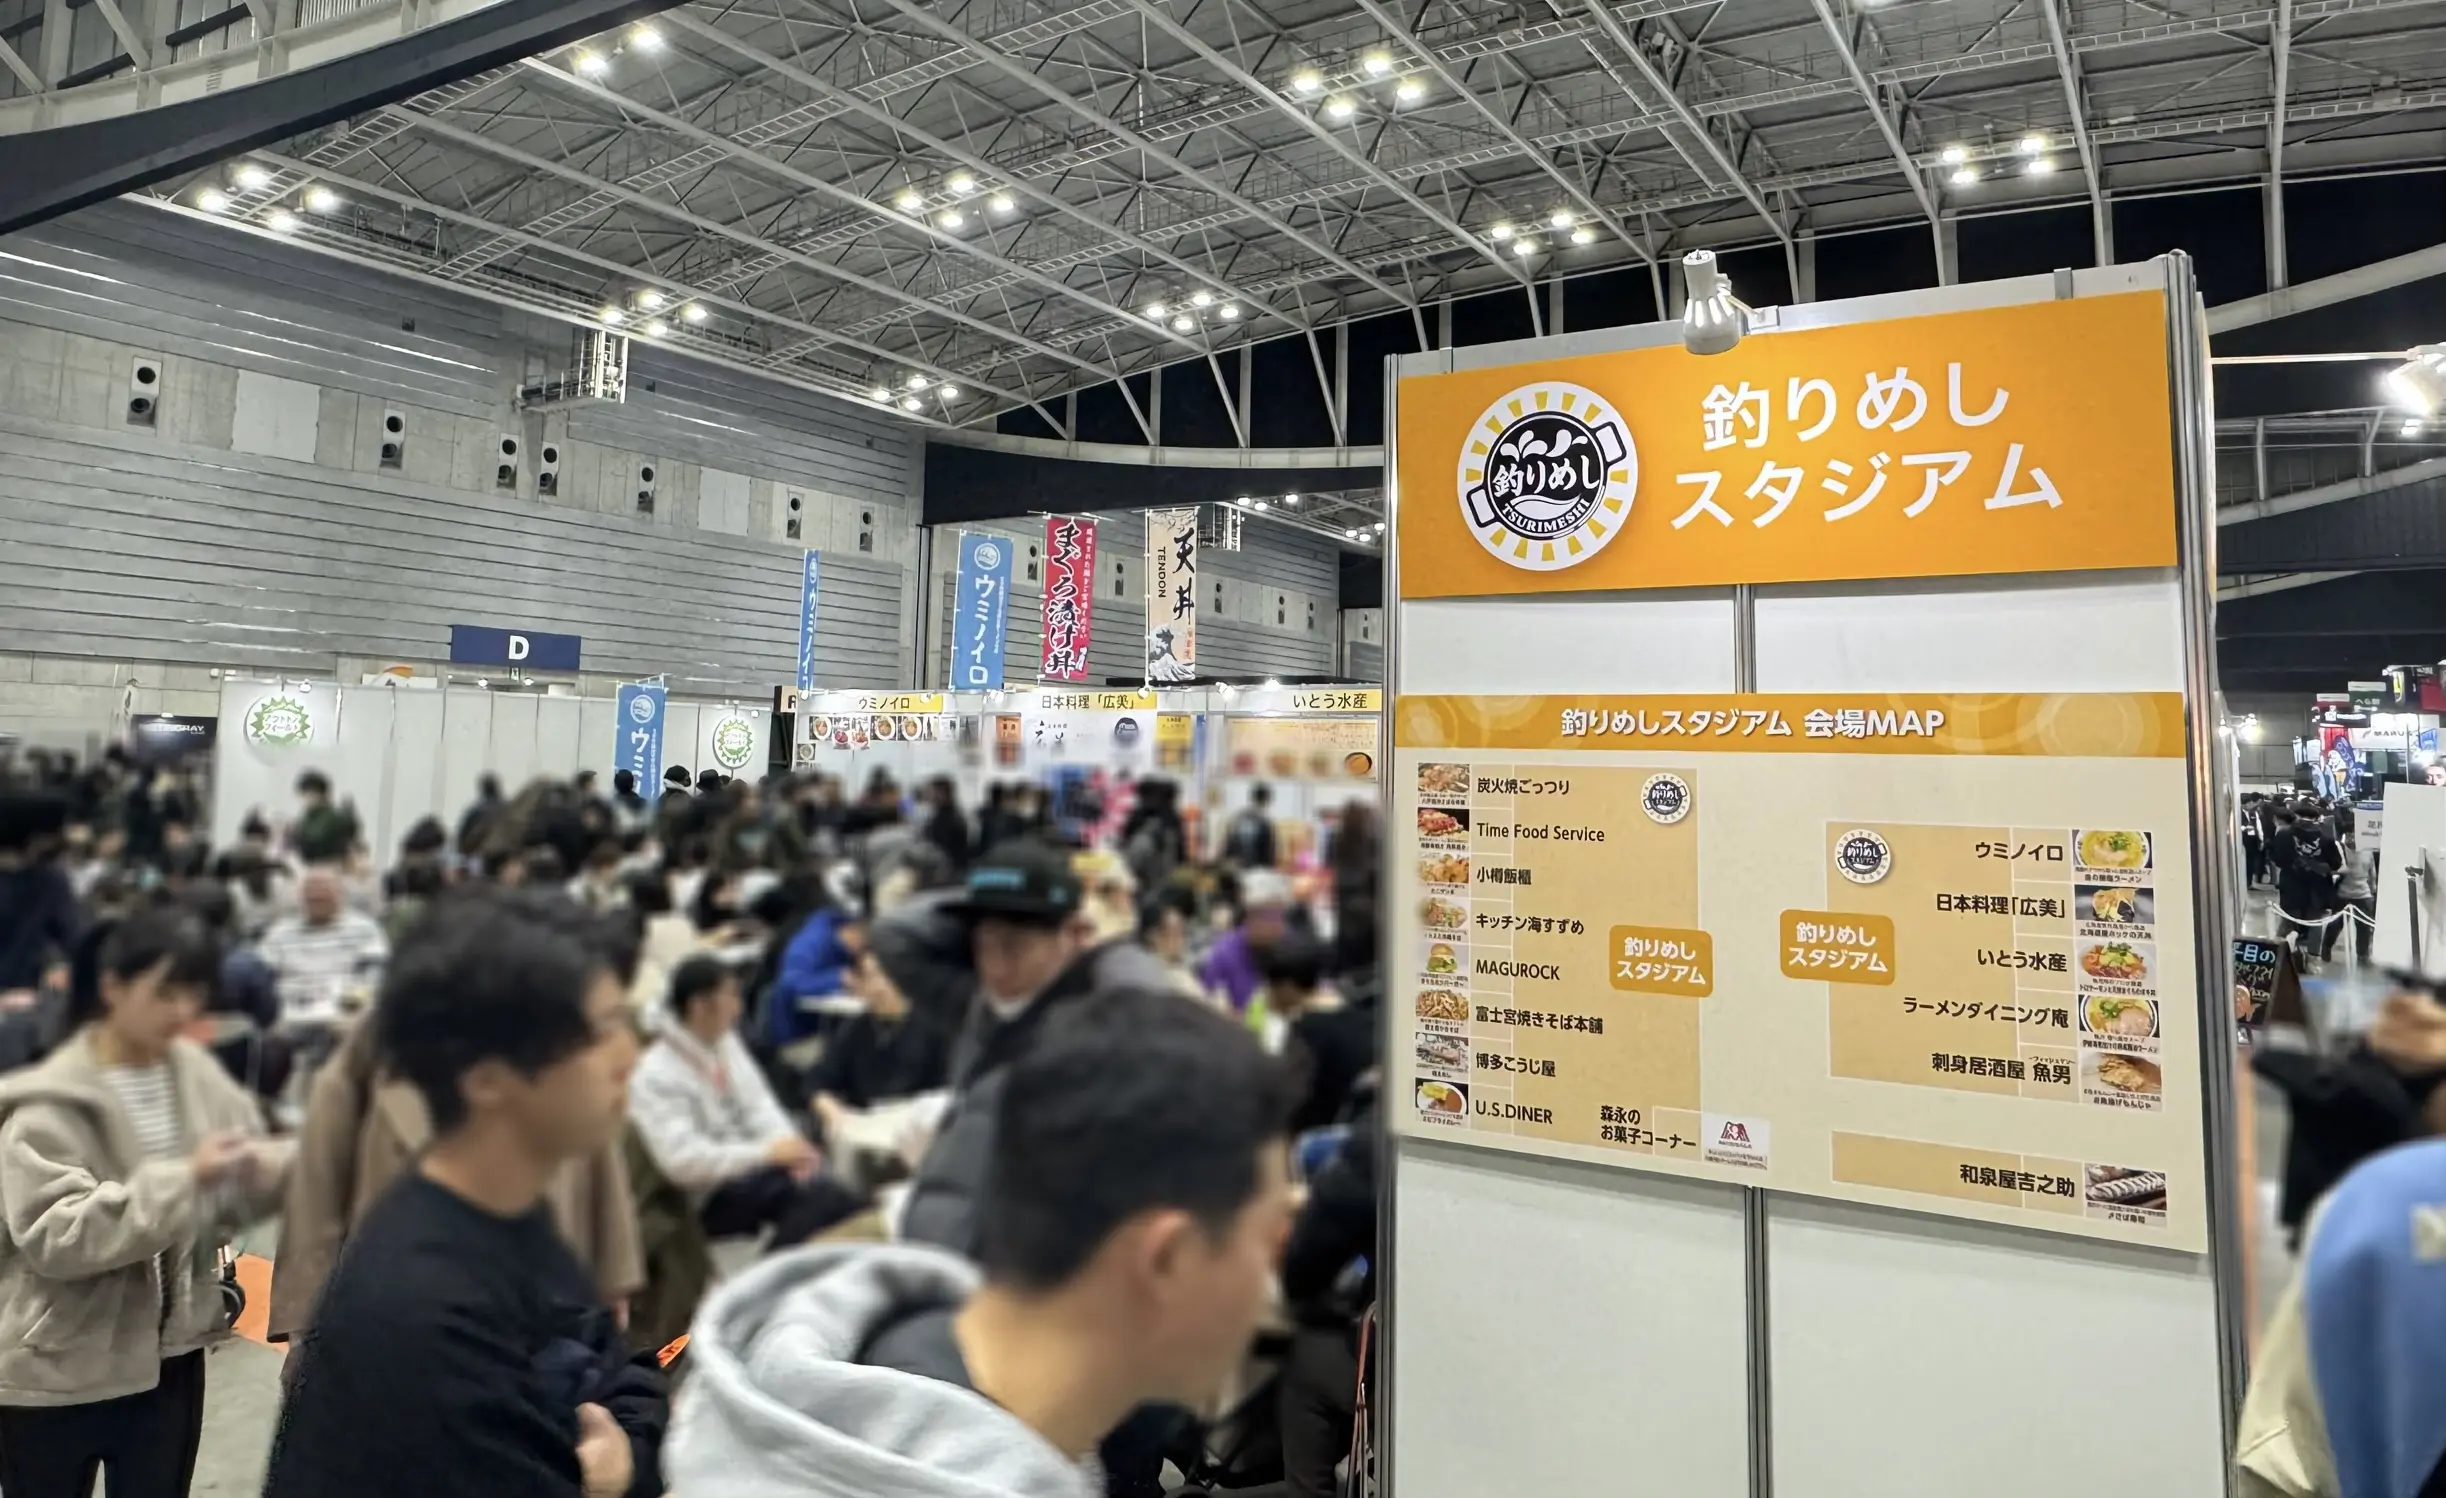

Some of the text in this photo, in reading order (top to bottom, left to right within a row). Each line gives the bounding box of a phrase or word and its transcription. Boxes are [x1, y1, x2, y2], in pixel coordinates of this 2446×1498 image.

[1701, 362, 2008, 451] 釣りめし
[1492, 455, 1600, 498] 釣りめし
[1671, 443, 2063, 530] スタジアム
[1501, 500, 1593, 532] TSURIMESHI
[1157, 546, 1167, 598] TENDON
[1173, 527, 1195, 625] 天丼
[969, 574, 996, 685] ウミノイロ
[508, 635, 530, 660] D
[858, 697, 910, 710] ウミノイロ
[1041, 694, 1135, 710] 日本料理「広美」
[1293, 693, 1368, 709] いとう水産
[1561, 709, 1945, 738] 釣りめしスタジアム 会場MAP
[1477, 777, 1570, 796] 炭火焼ごっつり
[1477, 822, 1605, 842] Time Food Service
[1975, 842, 2064, 862] ウミノイロ
[1476, 867, 1532, 886] 小樽飯櫃
[1936, 894, 2066, 918] 日本料理「広美」
[1476, 913, 1585, 936] キッチン海すずめ
[1796, 921, 1877, 947] 釣りめし
[1624, 936, 1697, 961] 釣りめし
[1789, 948, 1889, 973] スタジアム
[1476, 959, 1561, 981] MAGUROCK
[1616, 960, 1706, 985] スタジアム
[1977, 951, 2068, 973] いとう水産
[1476, 1005, 1604, 1035] 富士宮焼きそば本舗
[1903, 997, 2069, 1028] ラーメンダイニング庵
[1476, 1053, 1556, 1078] 博多こうじ屋
[1931, 1052, 2072, 1085] 刺身居酒屋 魚男
[1476, 1101, 1553, 1125] U.S.DINER
[1600, 1105, 1641, 1125] 森永の
[1600, 1126, 1697, 1148] お菓子コーナー
[1960, 1164, 2075, 1199] 和泉屋吉之助
